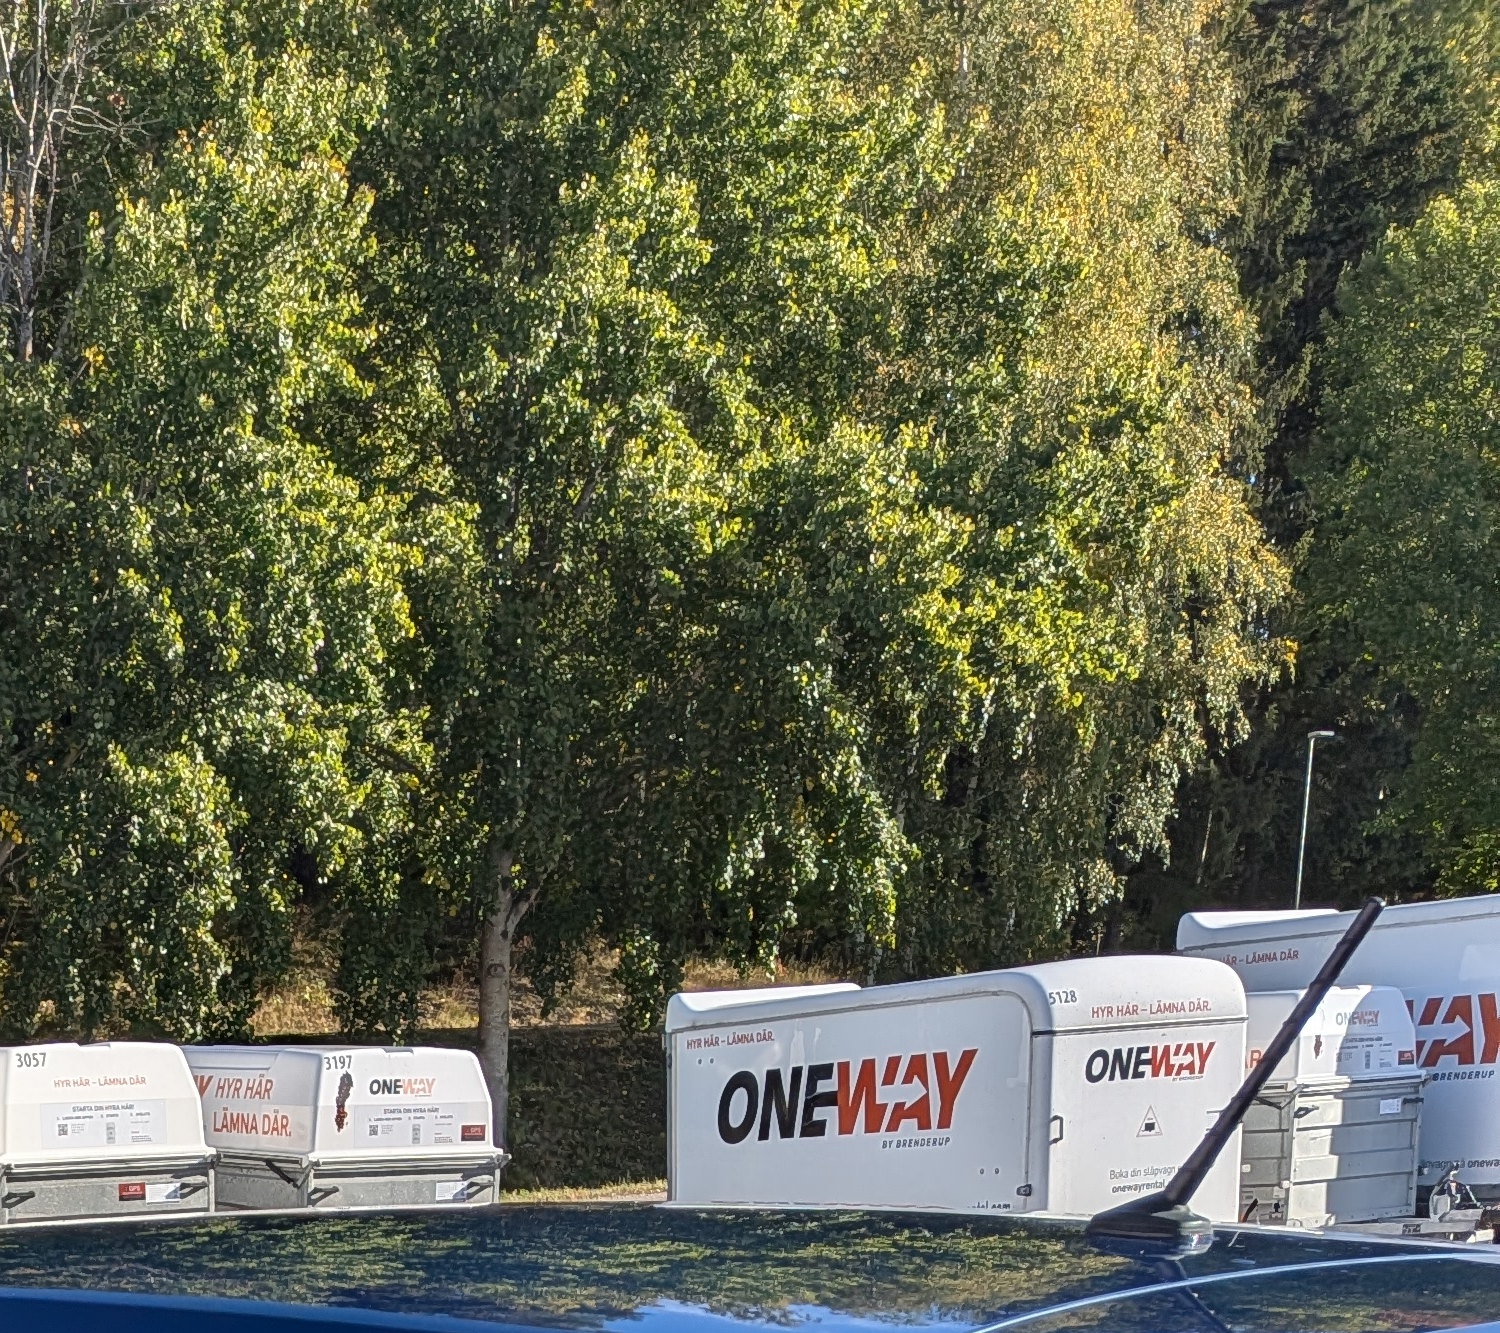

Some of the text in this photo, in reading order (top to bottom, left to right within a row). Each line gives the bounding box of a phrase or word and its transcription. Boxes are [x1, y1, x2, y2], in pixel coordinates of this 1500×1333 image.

[1245, 951, 1278, 965] LÄMNA
[1279, 948, 1299, 961] DÄR
[1048, 990, 1078, 1005] 5128
[1091, 1005, 1114, 1019] HYR
[1149, 1000, 1186, 1015] LÄMNA
[1188, 998, 1212, 1013] DÄR.
[686, 1038, 703, 1050] HYR
[703, 1034, 720, 1048] HÄR
[726, 1032, 755, 1046] LÄMNA
[15, 1052, 47, 1068] 3057
[323, 1054, 353, 1071] 3197
[1085, 1041, 1217, 1084] ONEWAY
[54, 1078, 72, 1088] HYR
[98, 1076, 128, 1087] LÄMNA
[214, 1077, 243, 1099] HYR
[244, 1073, 274, 1100] HÄR
[369, 1078, 437, 1096] ONEWAY
[717, 1048, 979, 1145] ONEWAY
[213, 1106, 292, 1137] LÄMNA DÄR.
[882, 1137, 951, 1149] BY BRENDERUP
